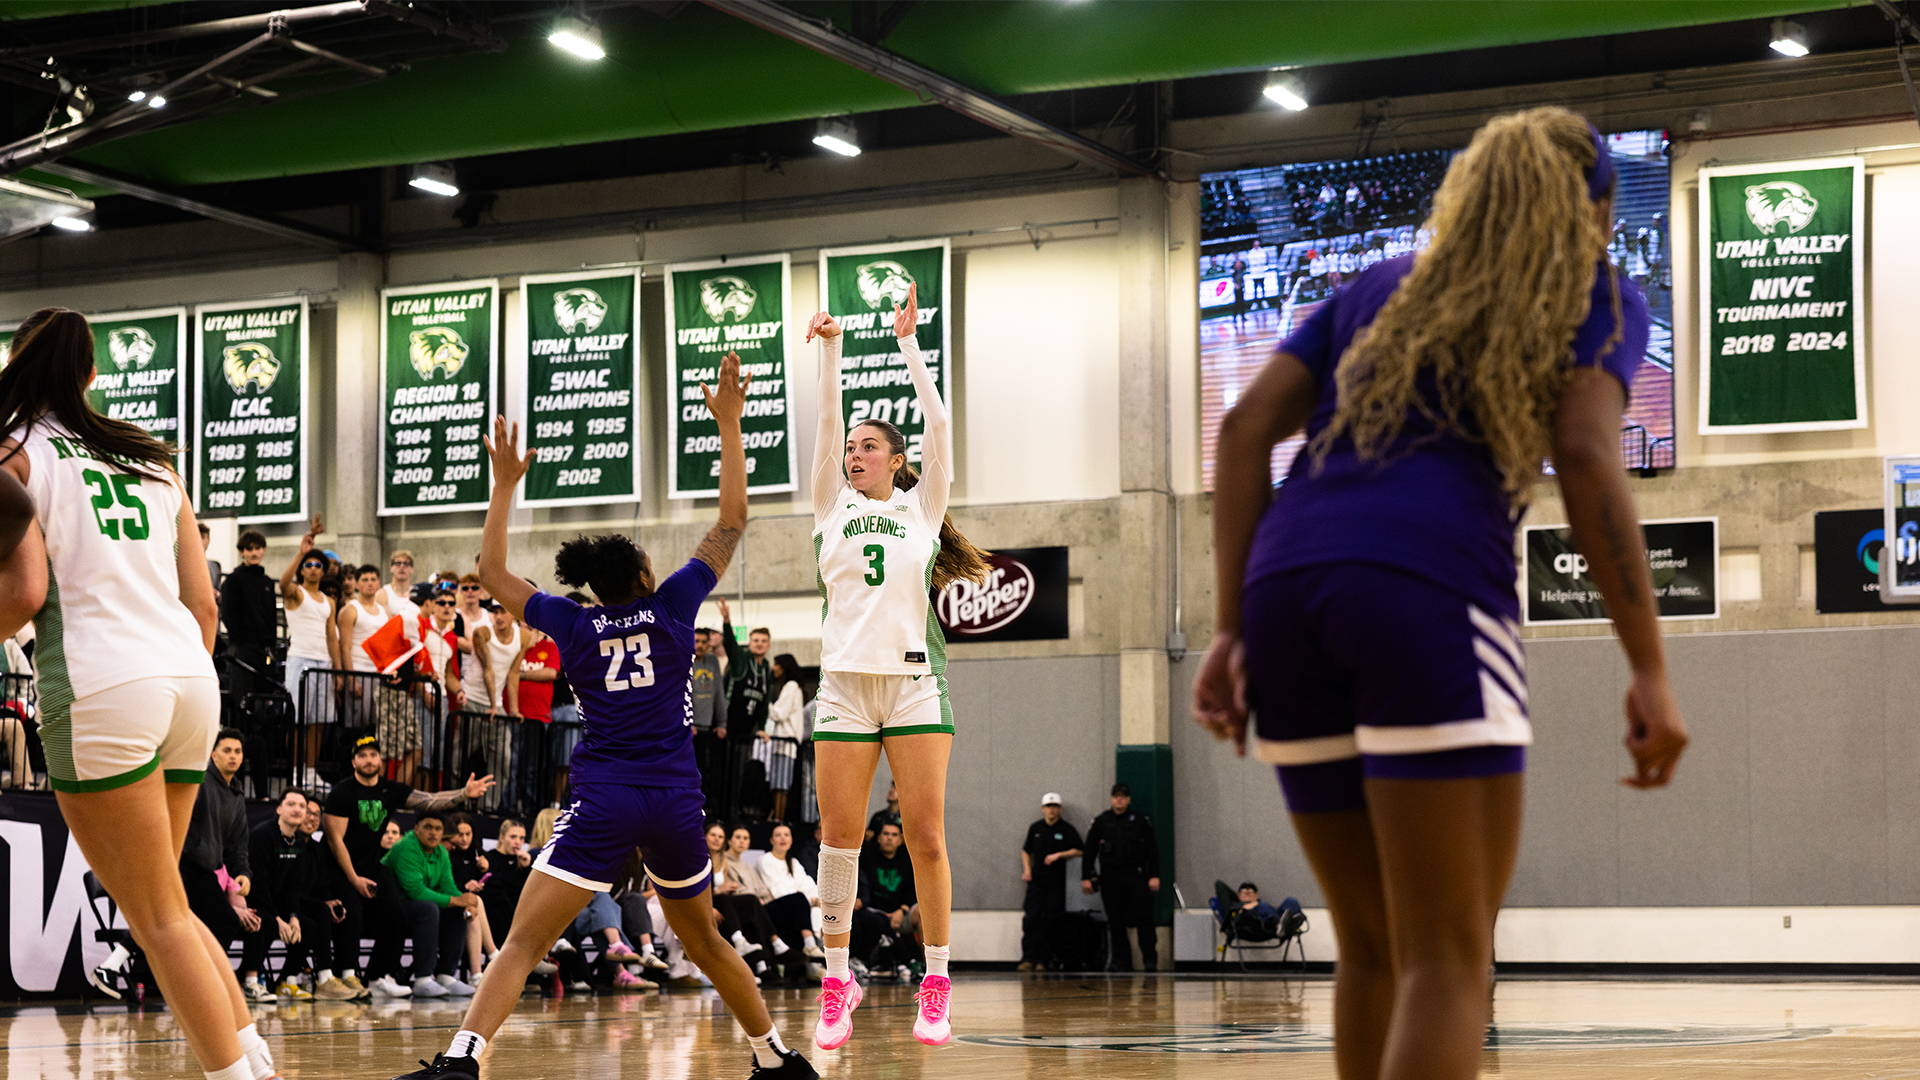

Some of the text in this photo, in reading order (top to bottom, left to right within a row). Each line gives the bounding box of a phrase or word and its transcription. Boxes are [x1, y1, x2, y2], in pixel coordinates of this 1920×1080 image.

[1716, 234, 1850, 259] UTAH VALLEY
[1741, 256, 1822, 268] VOLLEYBALL
[1750, 276, 1815, 301] NIVC
[391, 292, 488, 317] UTAH VALLEY
[1716, 301, 1848, 323] TOURNAMENT
[204, 309, 298, 332] UTAH VALLEY
[413, 313, 466, 326] VOLLEYBALL
[836, 307, 938, 332] UTAH VAEY
[226, 329, 277, 341] VOLLEYBALL
[532, 333, 630, 356] UTAH VALLEY
[678, 321, 782, 346] UTAH VALLEY
[1721, 331, 1848, 356] 2018 2024
[551, 353, 610, 363] VOLLEYBALL
[698, 341, 761, 353] VOLLEYBALL
[126, 368, 176, 388] VALLEY
[550, 368, 611, 392] SWAC
[682, 368, 716, 382] NCAA
[774, 362, 782, 375] I
[841, 366, 940, 391] CHAMPIOS
[106, 387, 158, 398] VOLLEYBALL
[394, 382, 480, 406] REGION 18
[533, 390, 630, 412] CHAMPIONS
[108, 400, 157, 420] NJCAA
[230, 396, 273, 418] ICAC
[390, 402, 484, 425] CHAMPIONS
[682, 398, 785, 422] CHAIONS
[204, 416, 298, 438] CHAMPIONS
[395, 425, 480, 446] 1984 1985
[536, 417, 627, 438] 1994 1995
[208, 440, 294, 462] 1983 1985
[742, 430, 785, 450] 2007
[396, 444, 480, 466] 1987 1992
[536, 442, 630, 464] 1997 2000
[208, 464, 294, 484] 1987 1988
[392, 464, 480, 485] 2000 2001
[556, 468, 602, 486] 2002
[710, 456, 757, 477] 28
[208, 487, 294, 508] 1989 1993
[417, 484, 458, 502] 2002
[82, 468, 150, 541] 25
[842, 516, 906, 539] WOLVERINES
[863, 544, 884, 586] 3
[1650, 548, 1673, 560] pest
[1650, 557, 1688, 570] control
[972, 568, 1006, 598] Dr
[946, 576, 1028, 628] Pepper
[1541, 589, 1587, 604] Helping
[599, 632, 655, 692] 23
